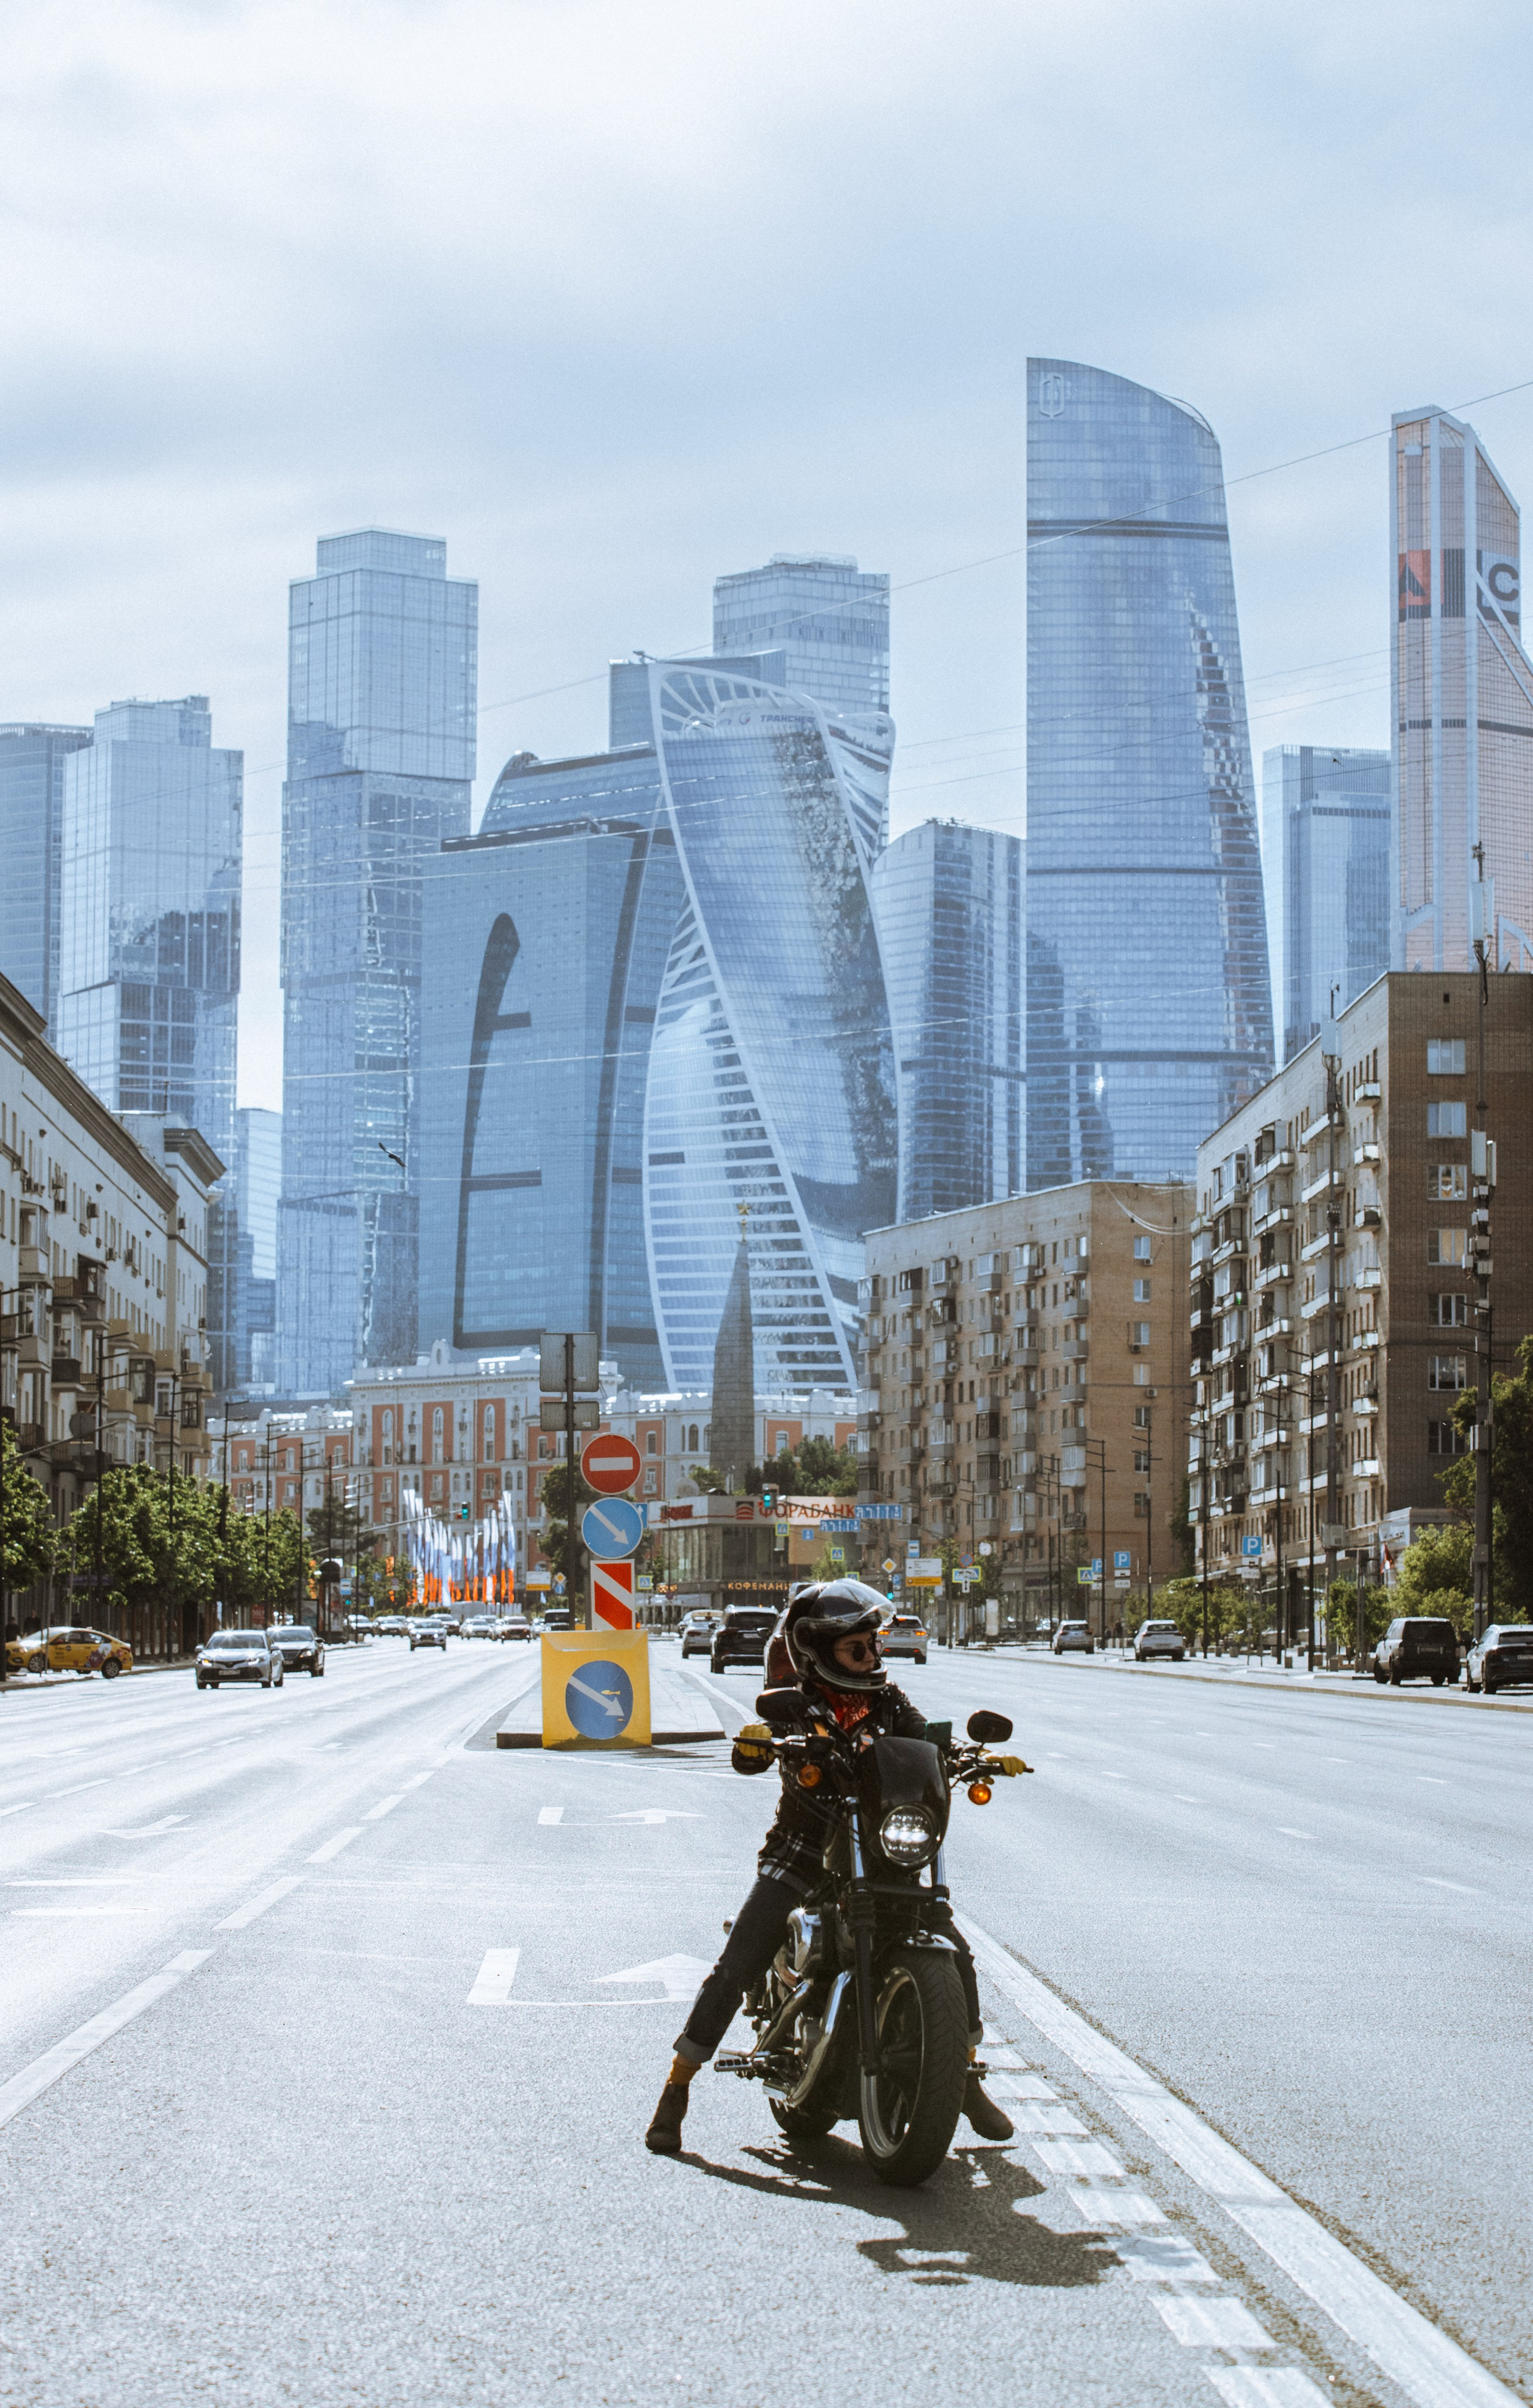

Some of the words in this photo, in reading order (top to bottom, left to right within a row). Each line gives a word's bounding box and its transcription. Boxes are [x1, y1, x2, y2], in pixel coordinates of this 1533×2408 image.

[759, 1503, 855, 1519] ФОРАБАНК
[1247, 1537, 1259, 1553] P
[1119, 1553, 1127, 1566] P
